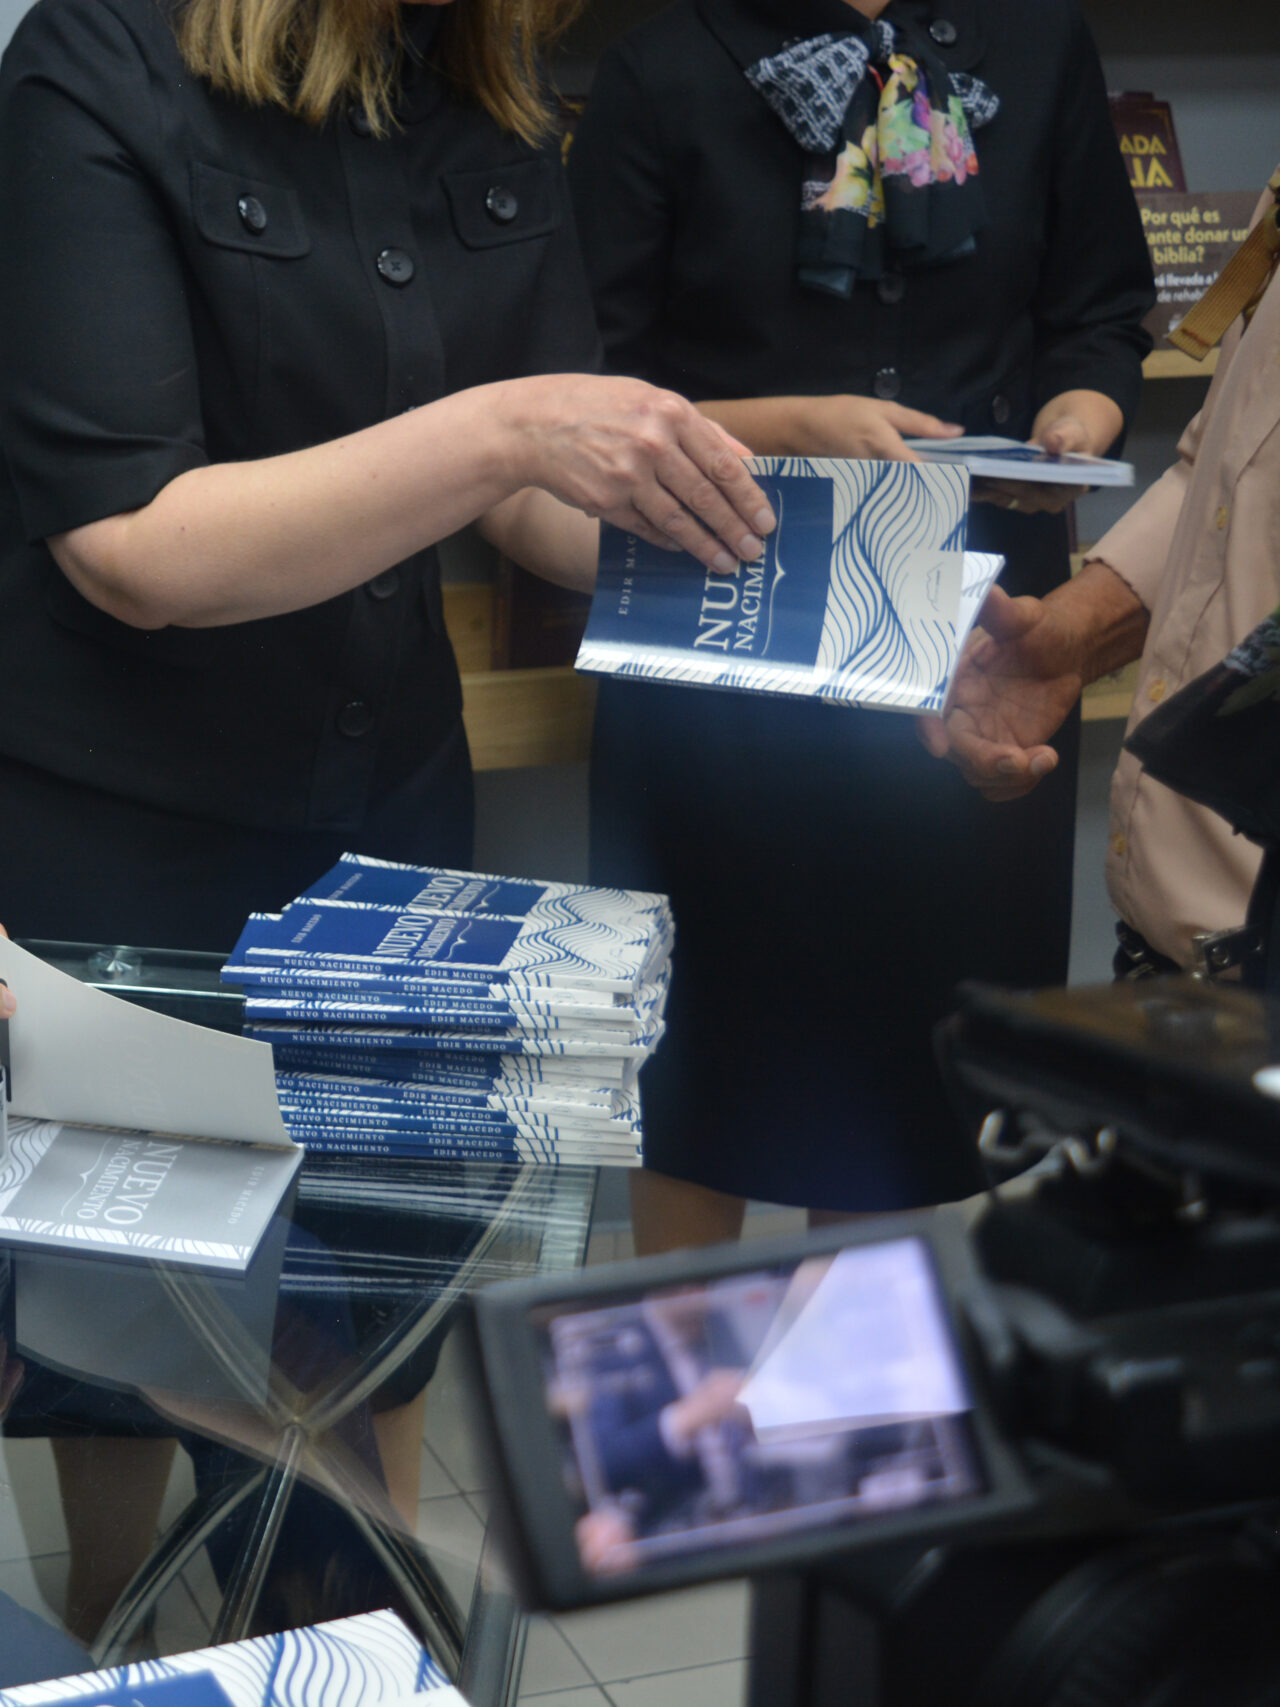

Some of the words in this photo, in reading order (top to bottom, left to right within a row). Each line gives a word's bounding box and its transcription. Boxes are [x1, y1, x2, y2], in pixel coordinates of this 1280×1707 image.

[1170, 205, 1201, 229] qué
[1203, 209, 1221, 224] es
[1144, 229, 1182, 245] ante
[1184, 225, 1229, 244] donar
[1153, 244, 1206, 265] biblia?
[618, 577, 634, 615] EDIR
[626, 535, 638, 569] MAC
[694, 560, 740, 650] NU
[405, 876, 464, 910] UEVO
[372, 915, 433, 958] NUEVO
[284, 958, 316, 967] NUEVO
[319, 960, 382, 972] NACIMIENTO
[260, 975, 292, 984] NUEVO
[297, 977, 360, 987] NACIMIENTO
[424, 969, 449, 977] EDIR
[453, 971, 493, 980] MACEDO
[281, 989, 313, 998] NUEVO
[317, 991, 380, 1002] NACIMIENTO
[403, 984, 428, 992] EDIR
[432, 986, 473, 994] MACEDO
[423, 999, 447, 1007] EDIR
[452, 1001, 493, 1009] MACEDO
[285, 1010, 318, 1018] NUEVO
[322, 1010, 387, 1020] NACIMIENTO
[460, 1016, 501, 1024] MACEDO
[292, 1034, 325, 1042] NUEVO
[329, 1035, 393, 1045] NACIMIENTO
[436, 1040, 461, 1048] EDIR
[465, 1042, 506, 1050] MACEDO
[446, 1063, 487, 1074] MACEDO
[276, 1078, 294, 1087] EVO
[297, 1080, 360, 1093] NACIMIENTO
[412, 1073, 435, 1081] EDIR
[440, 1076, 478, 1087] MACEDO
[280, 1096, 312, 1104] NUEVO
[316, 1099, 379, 1111] NACIMIENTO
[403, 1091, 427, 1099] EDIR
[431, 1093, 472, 1104] MACEDO
[288, 1113, 321, 1122] NUEVO
[324, 1115, 389, 1126] NACIMIENTO
[422, 1108, 446, 1116] EDIR
[450, 1110, 491, 1119] MACEDO
[432, 1122, 456, 1130] EDIR
[460, 1124, 502, 1133] MACEDO
[323, 1131, 385, 1142] NACIMIENTO
[428, 1137, 452, 1145] EDIR
[456, 1139, 498, 1148] MACEDO
[305, 1142, 323, 1150] EVO
[326, 1143, 390, 1153] NACIMIENTO
[433, 1148, 457, 1156] EDIR
[461, 1150, 502, 1158] MACEDO
[76, 1138, 144, 1220] NACIMIENTO
[104, 1140, 184, 1225] NUEVO
